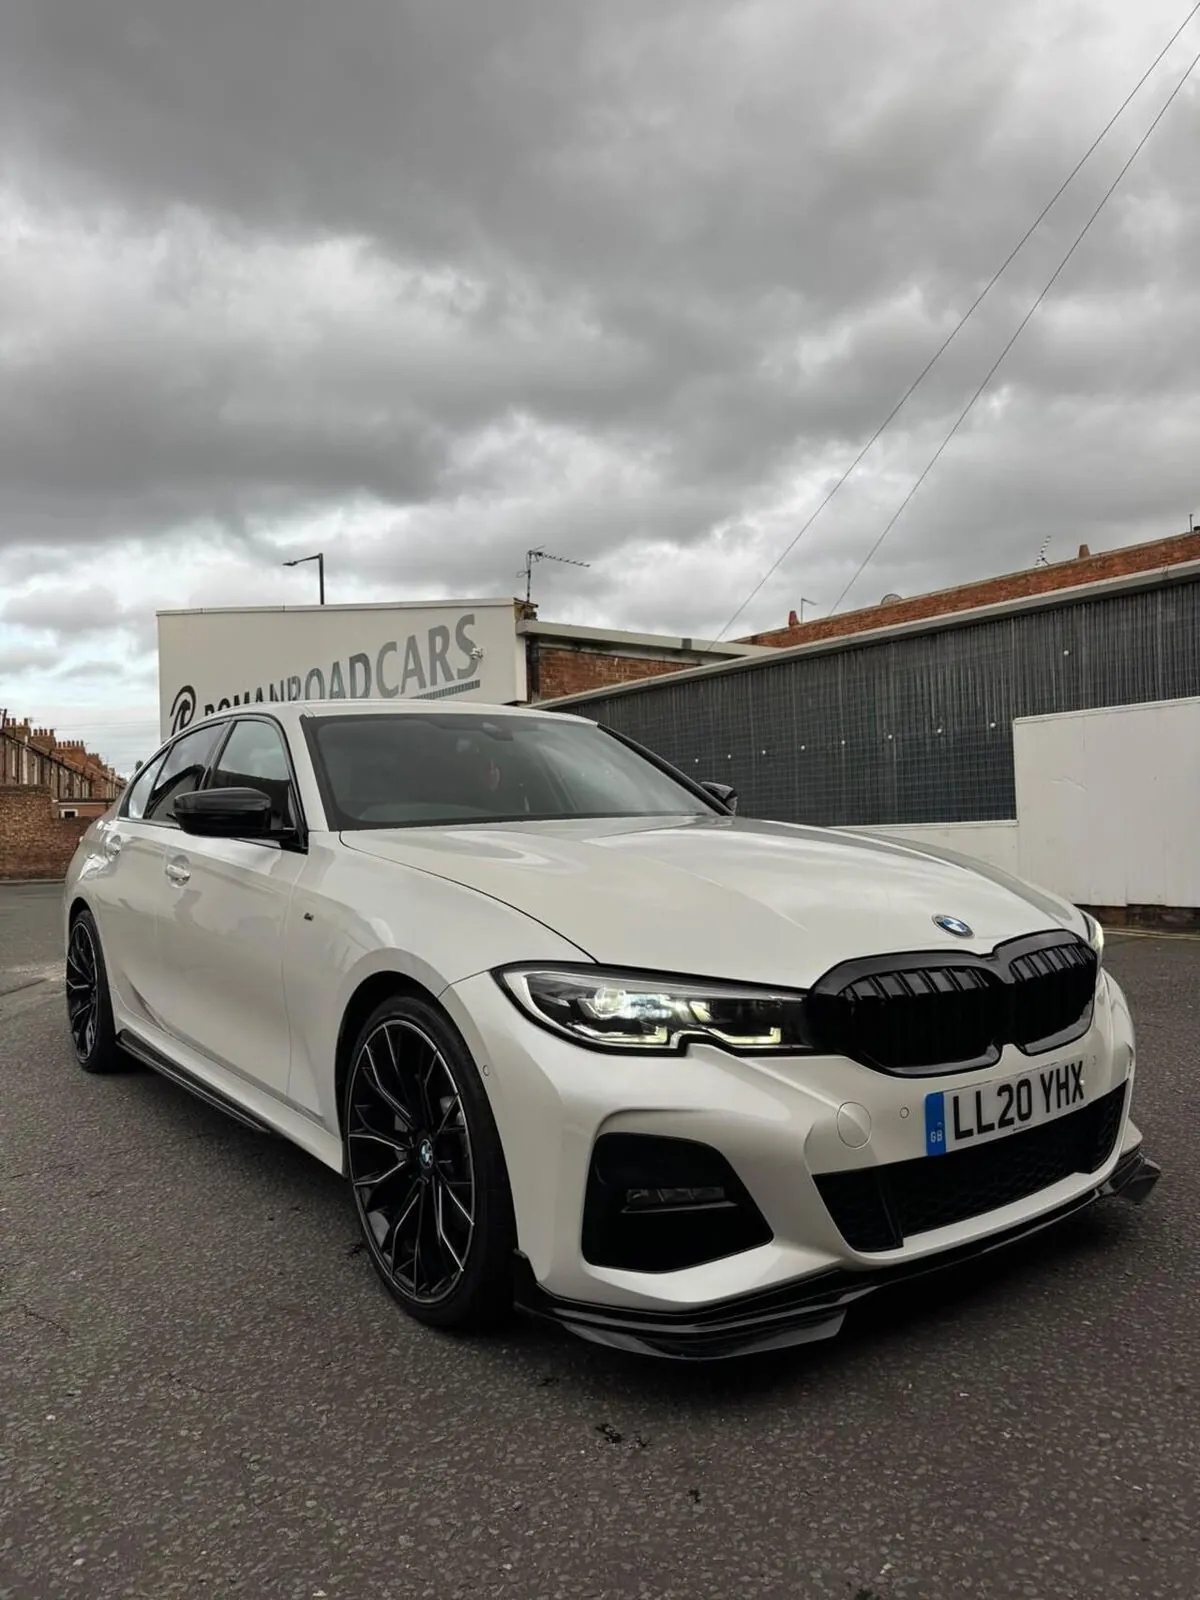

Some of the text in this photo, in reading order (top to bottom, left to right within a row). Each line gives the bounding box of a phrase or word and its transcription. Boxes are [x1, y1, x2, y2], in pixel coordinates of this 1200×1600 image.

[953, 1061, 1084, 1140] LL20 YHX
[930, 1129, 943, 1144] GB
